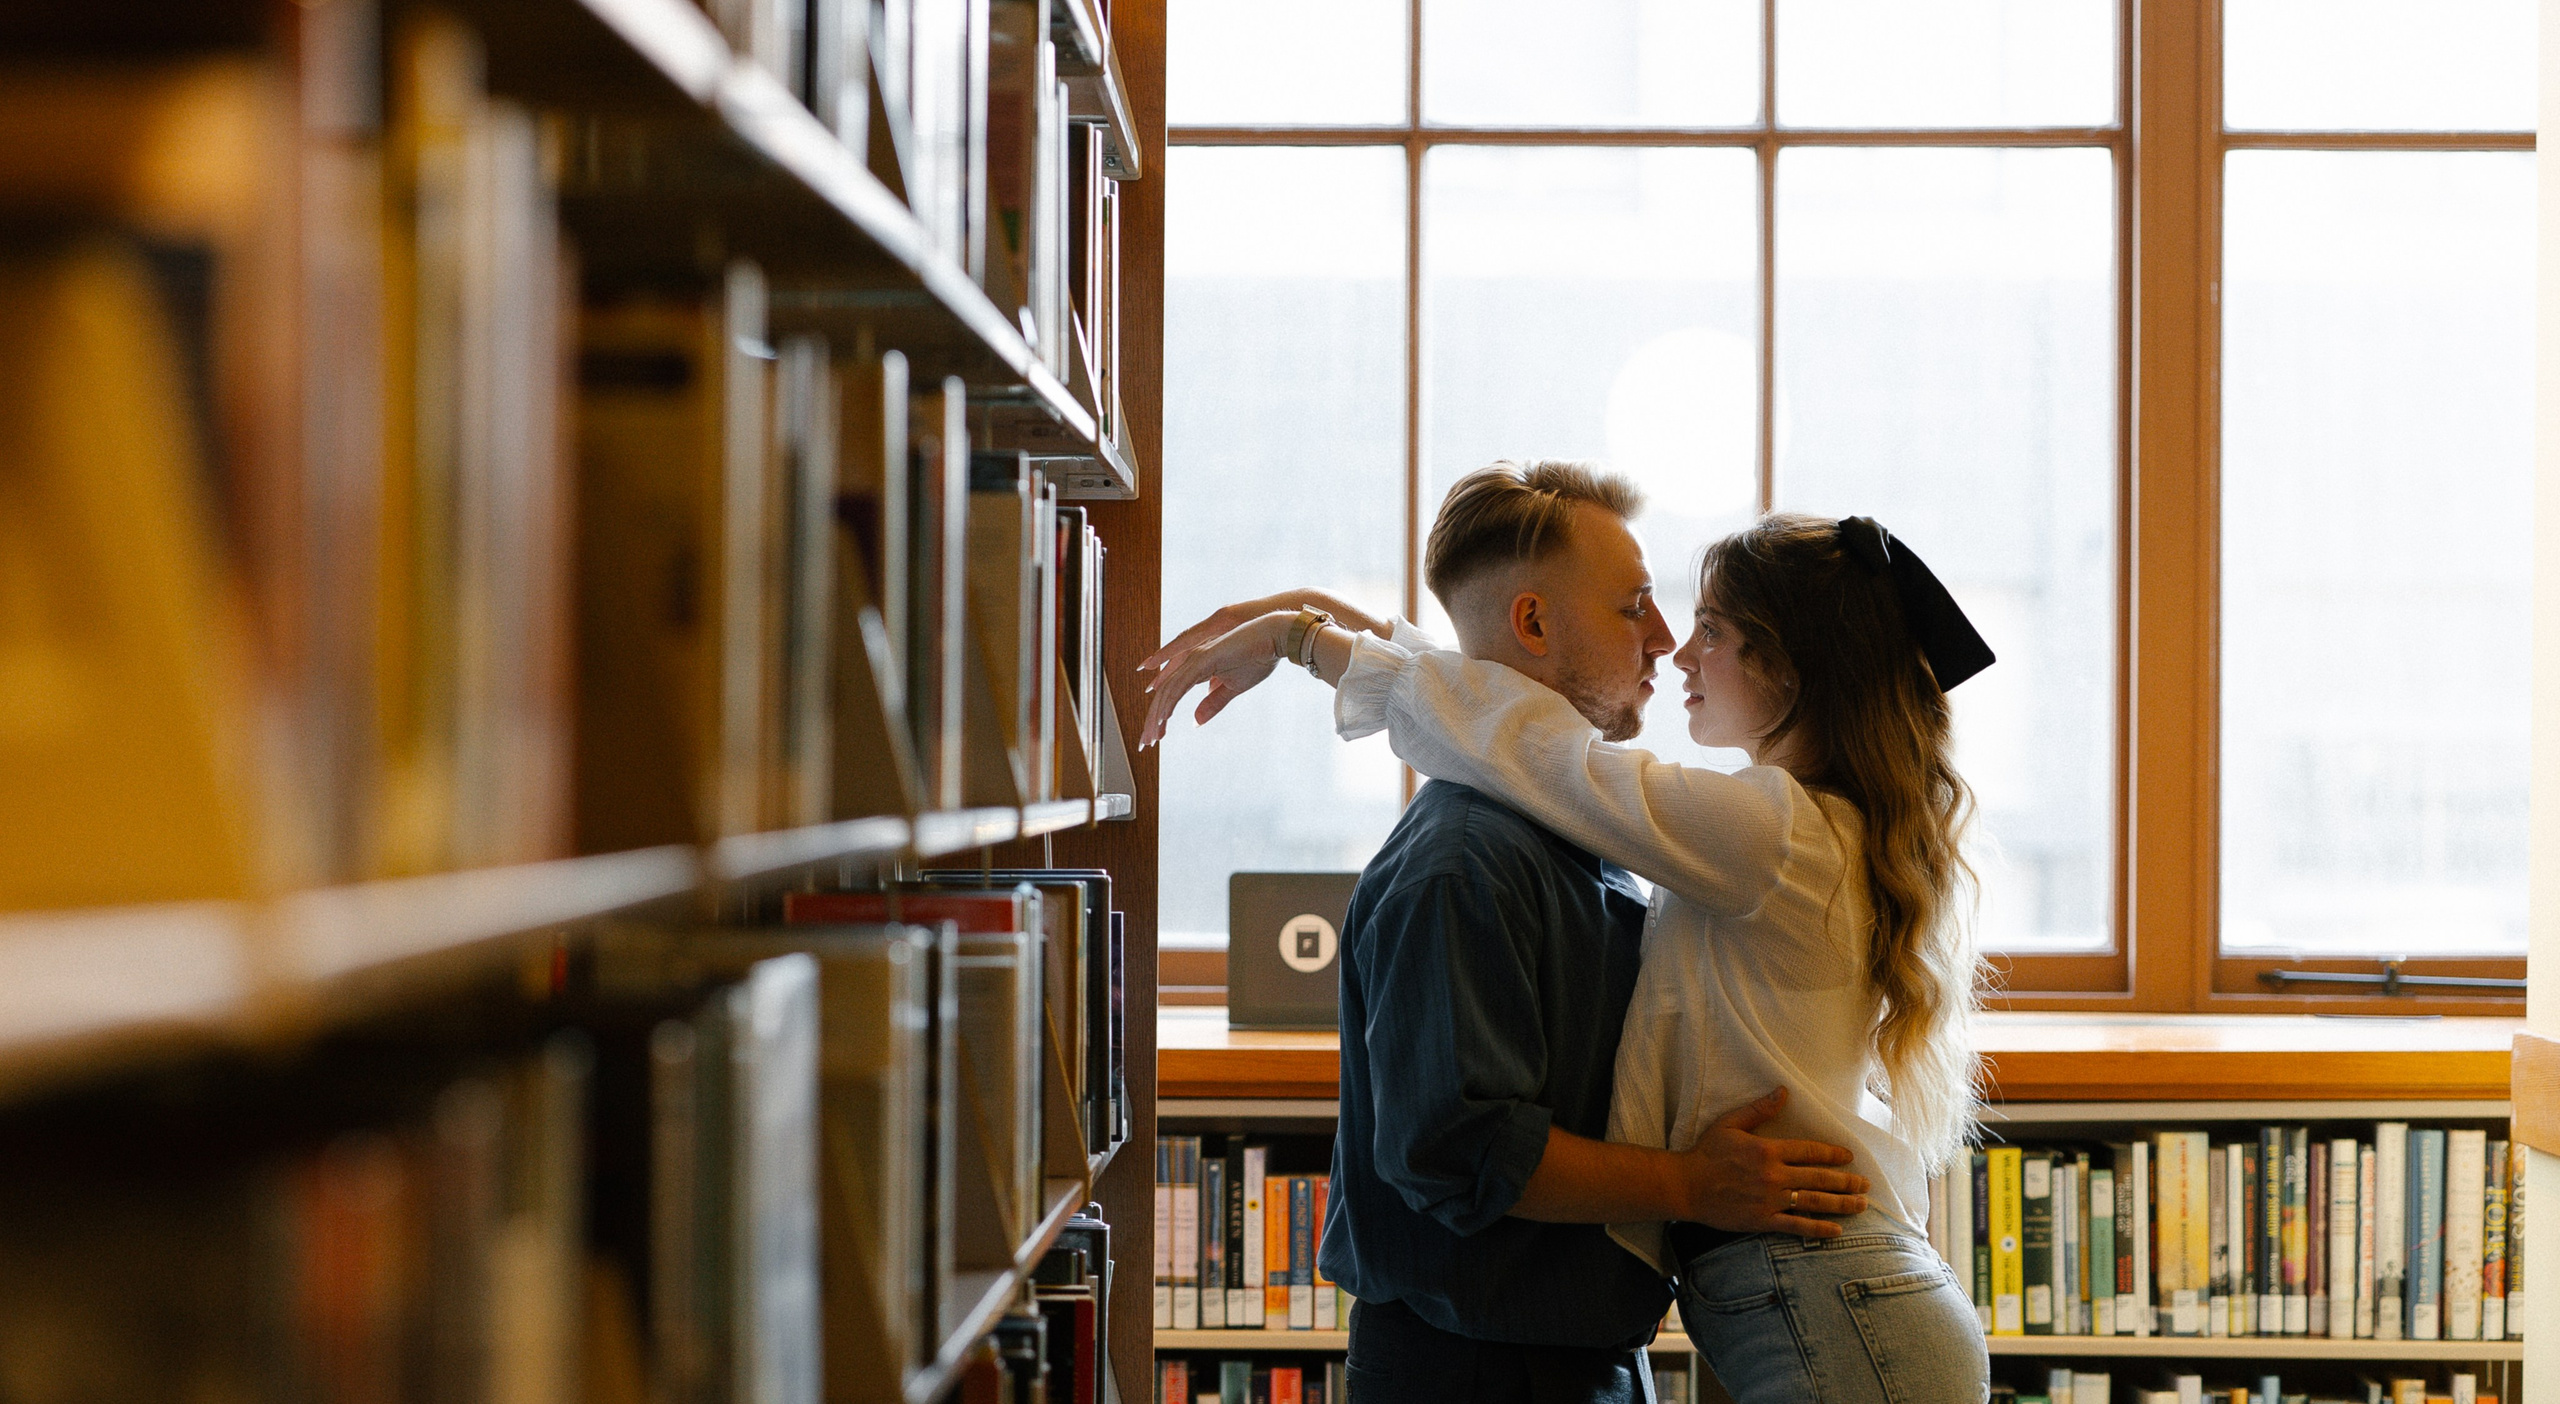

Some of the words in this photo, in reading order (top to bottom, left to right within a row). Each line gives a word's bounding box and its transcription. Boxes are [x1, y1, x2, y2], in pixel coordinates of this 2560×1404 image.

[2267, 1144, 2280, 1157] BY
[2267, 1159, 2280, 1180] WAY
[2267, 1182, 2280, 1195] OF
[1231, 1180, 1241, 1239] AWAKEN
[2267, 1196, 2280, 1237] SORROW
[2486, 1188, 2507, 1259] FOLK
